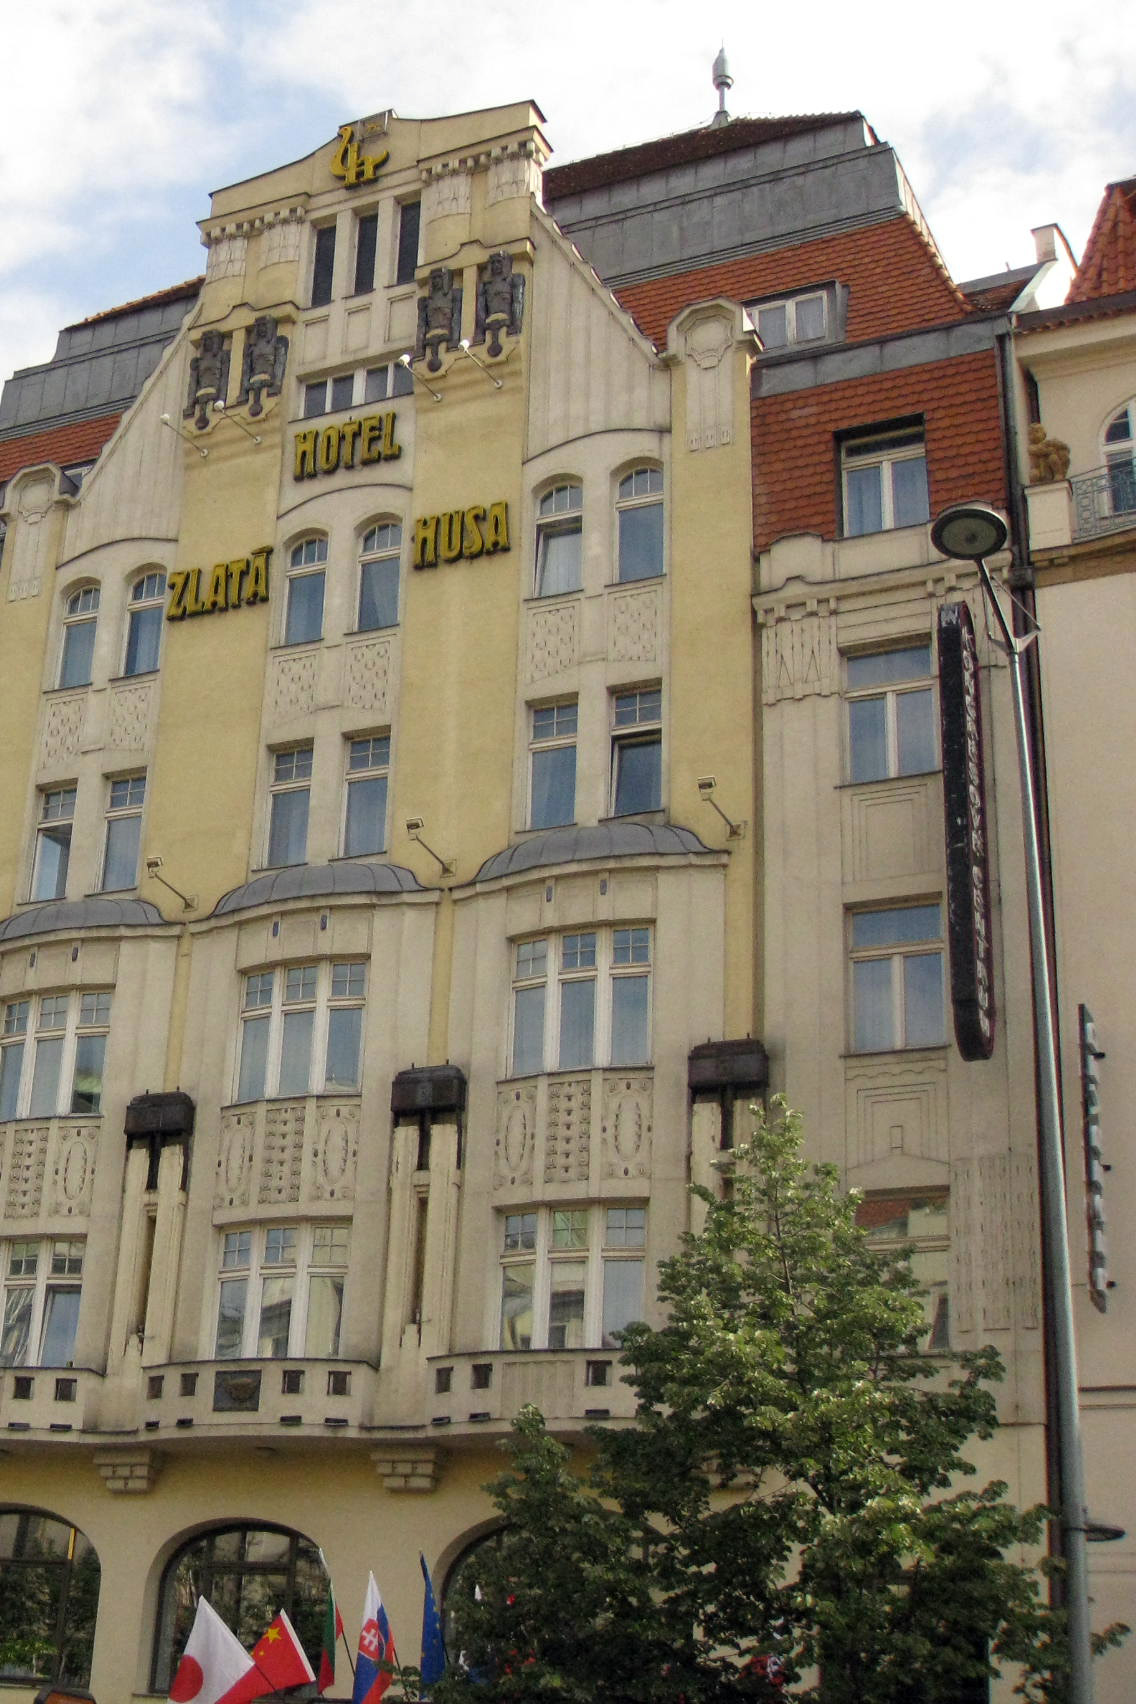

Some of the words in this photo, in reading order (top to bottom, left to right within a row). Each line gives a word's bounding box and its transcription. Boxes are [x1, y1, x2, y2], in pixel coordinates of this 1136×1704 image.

[293, 410, 402, 482] HOTEL
[413, 499, 512, 570] HUSA
[165, 545, 273, 622] ZLATÁ
